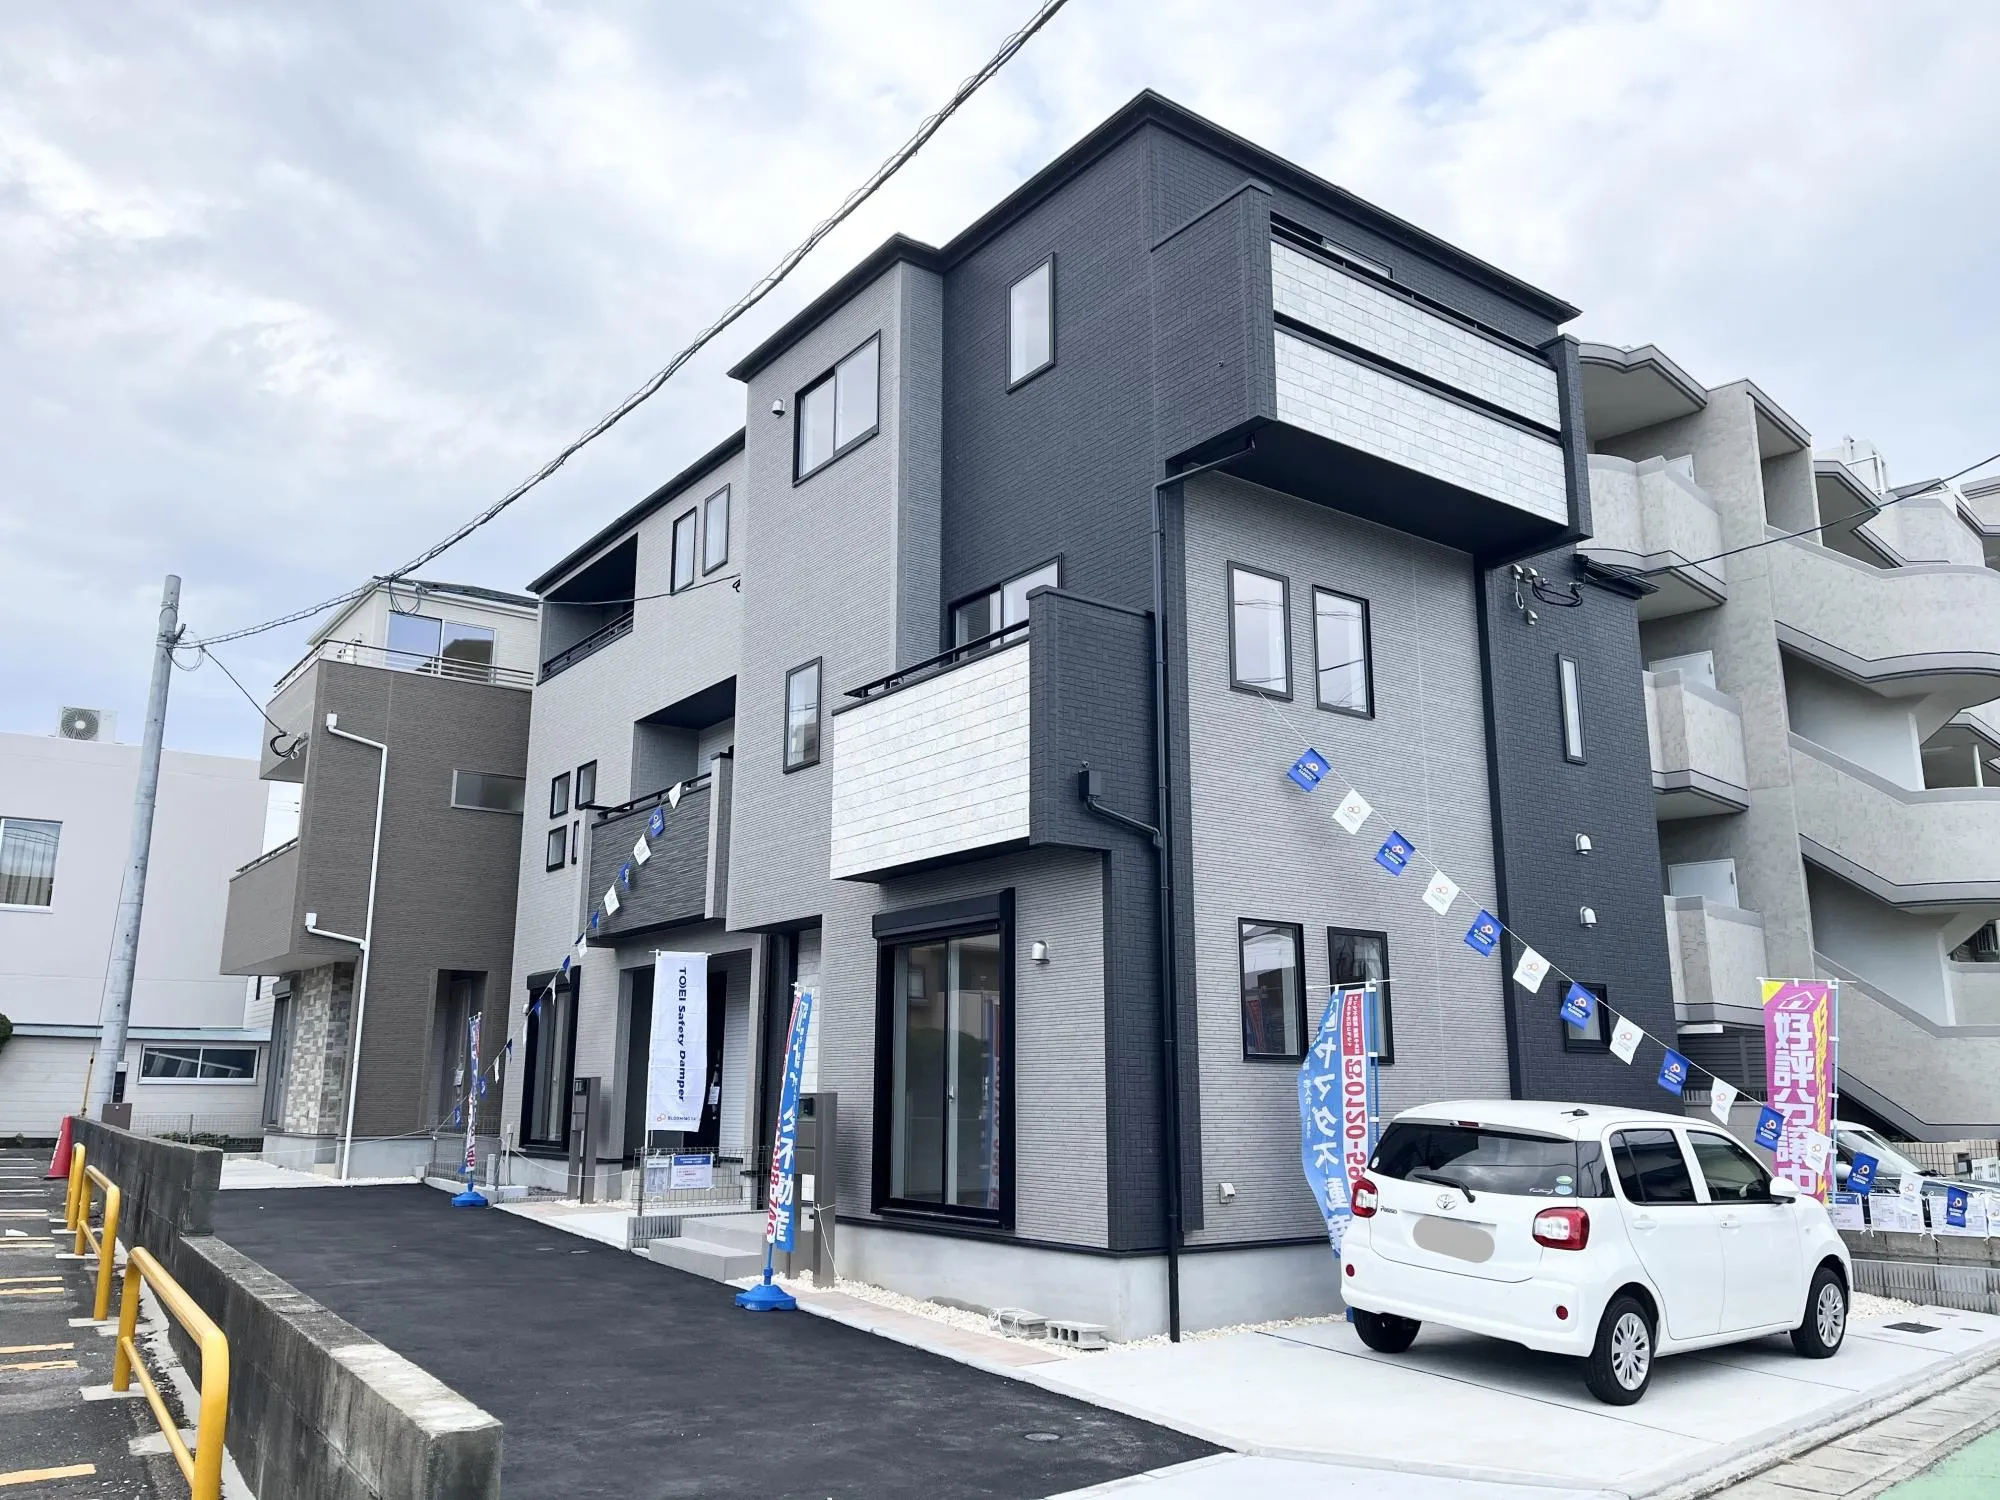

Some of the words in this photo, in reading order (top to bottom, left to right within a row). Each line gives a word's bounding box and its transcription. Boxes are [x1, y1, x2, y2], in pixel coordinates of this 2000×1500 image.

[677, 1005, 686, 1046] Safety
[676, 1050, 686, 1102] Damper
[1774, 1013, 1816, 1195] 好評分譲中
